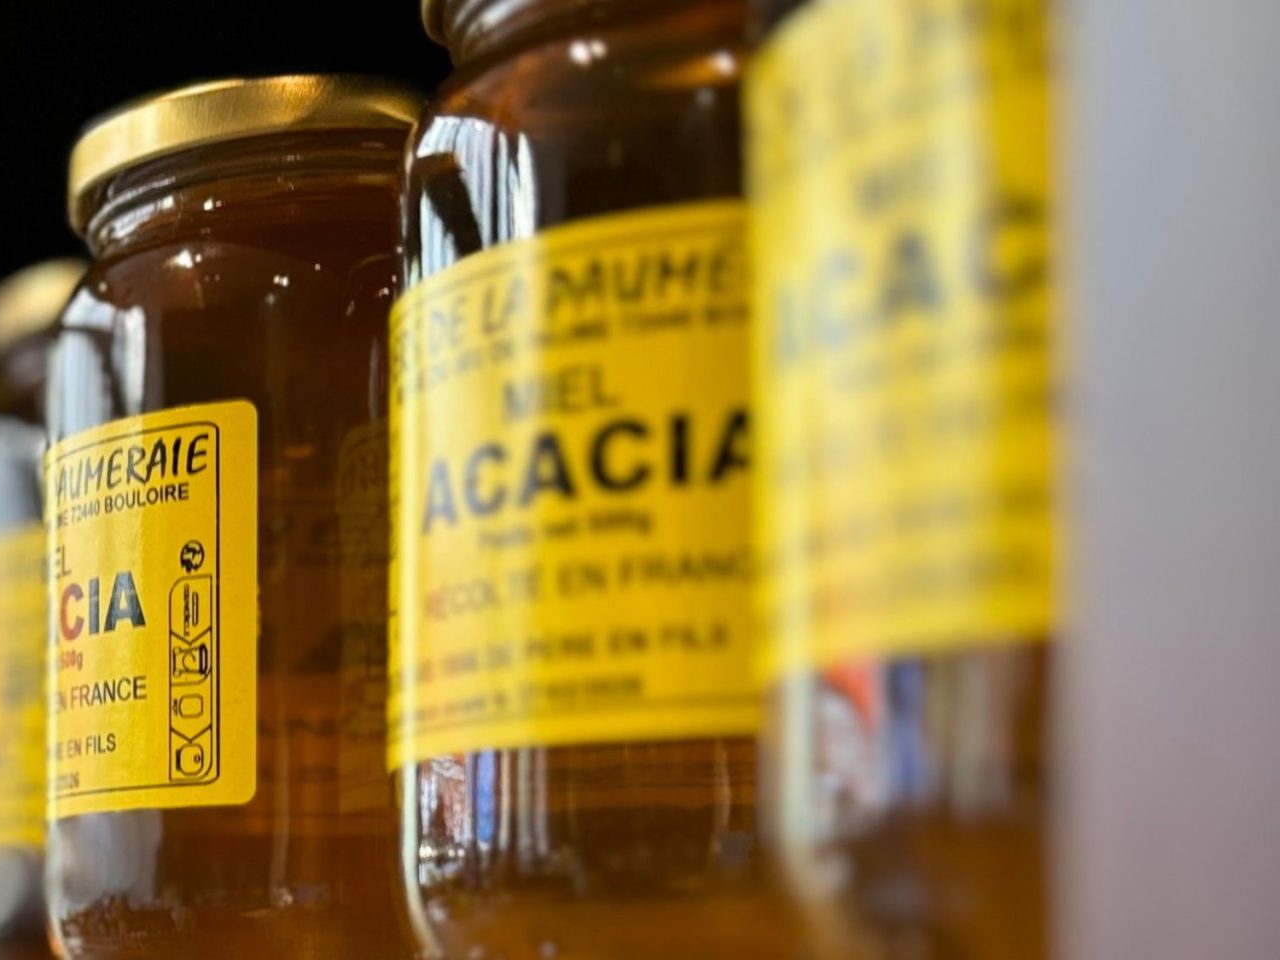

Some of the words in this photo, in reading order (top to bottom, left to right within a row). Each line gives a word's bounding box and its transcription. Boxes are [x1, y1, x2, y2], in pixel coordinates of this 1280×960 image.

[56, 433, 209, 506] AUMERAIE
[422, 406, 752, 535] ACACIA
[104, 482, 190, 514] BOULOIRE
[57, 570, 146, 641] CIA
[70, 675, 147, 709] FRANCE
[85, 732, 117, 756] FILS
